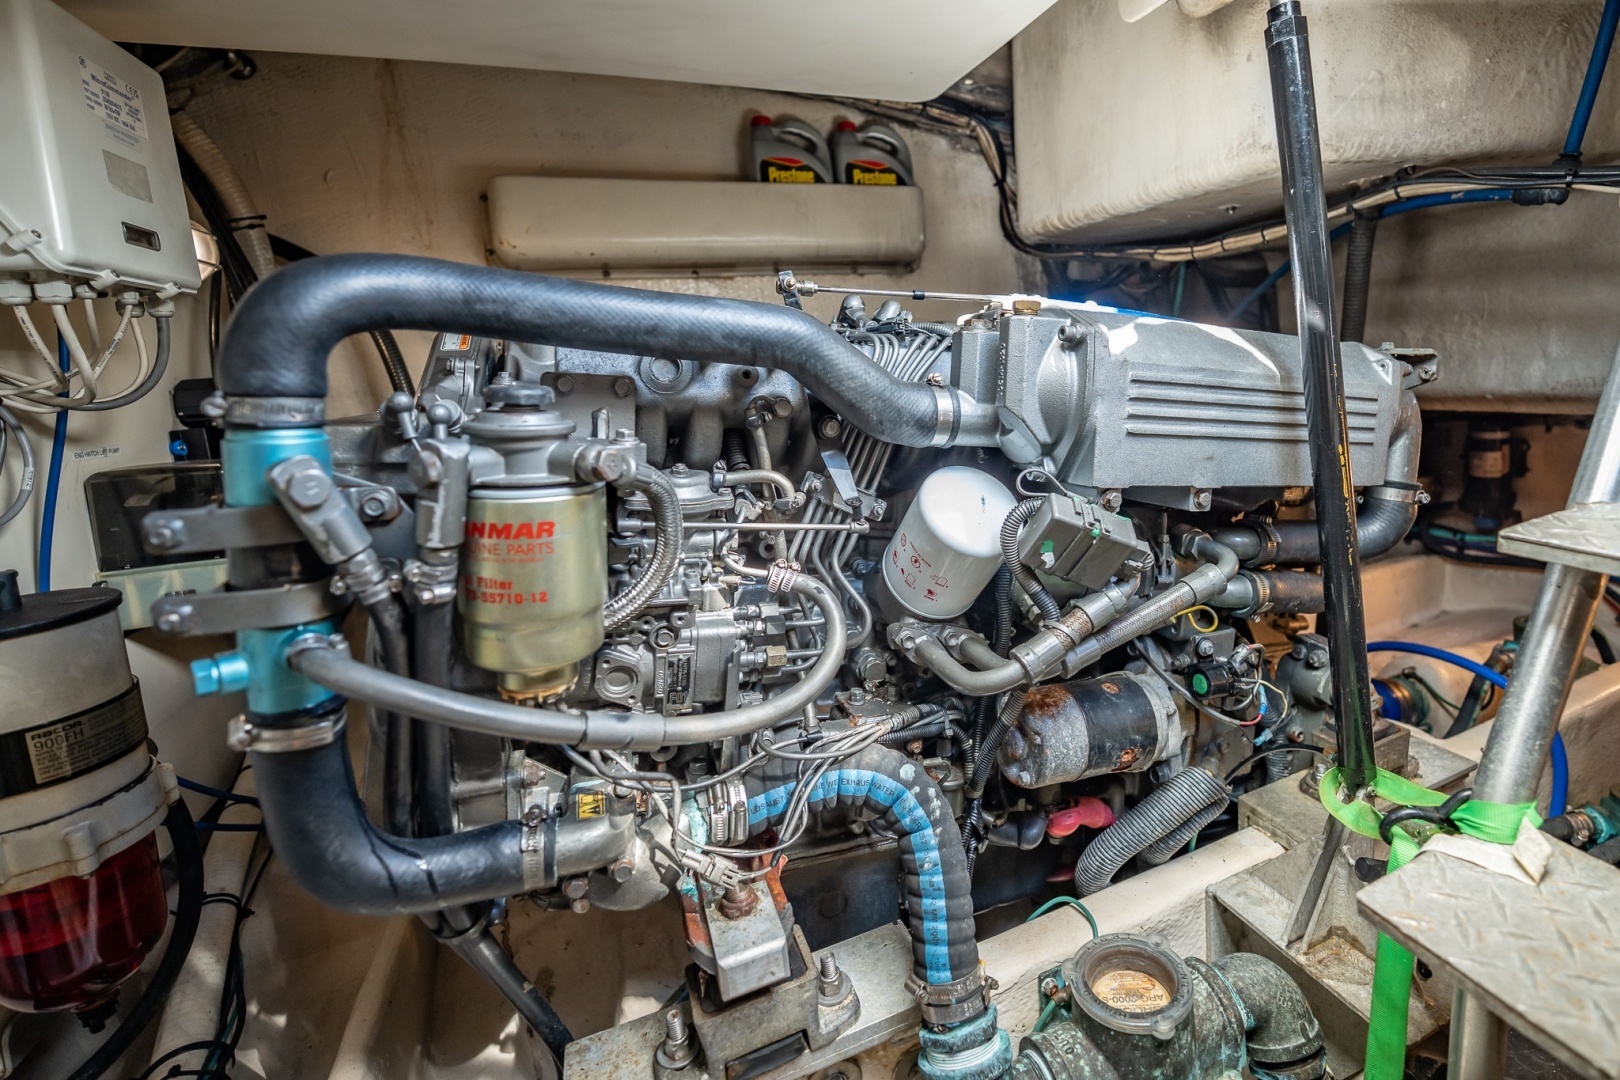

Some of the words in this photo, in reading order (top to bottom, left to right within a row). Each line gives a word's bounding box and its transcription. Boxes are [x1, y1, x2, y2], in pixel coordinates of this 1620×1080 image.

[768, 166, 815, 183] Prestone
[853, 169, 897, 185] Prestone
[466, 521, 555, 540] NMAR
[505, 541, 554, 556] PARTS
[477, 576, 513, 590] Filter
[33, 727, 85, 752] 900FH
[841, 778, 870, 787] EXHAUS
[871, 782, 895, 797] WATER
